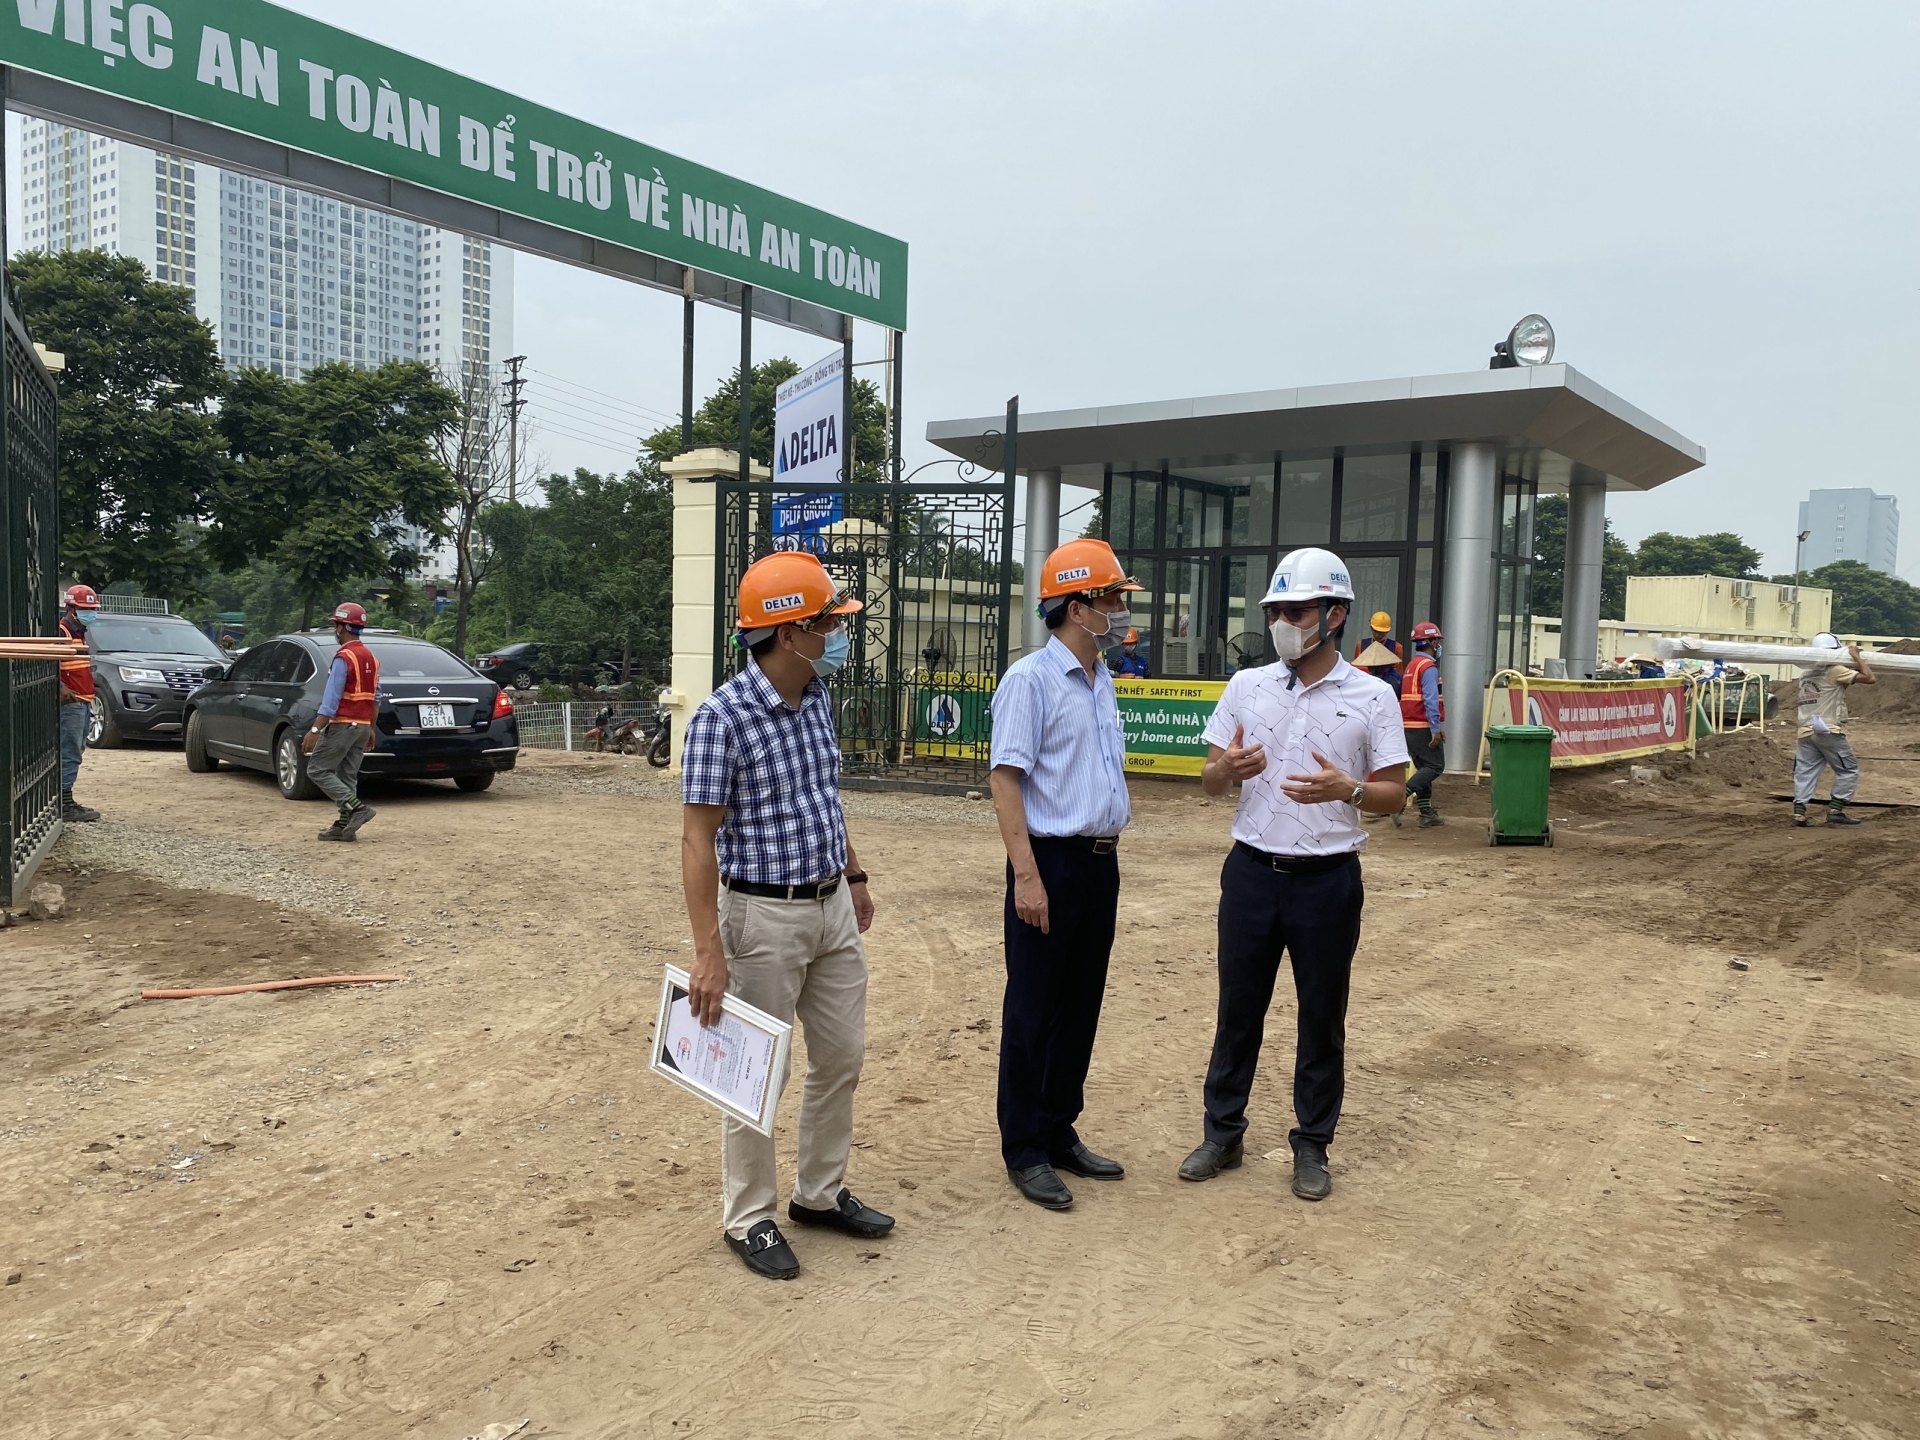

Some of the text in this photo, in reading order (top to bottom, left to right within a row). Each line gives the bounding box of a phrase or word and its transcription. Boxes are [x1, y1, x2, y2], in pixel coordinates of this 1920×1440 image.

[196, 25, 280, 106] AN
[299, 59, 440, 158] TOÀN
[458, 114, 516, 182] ĐỂ
[530, 151, 612, 210] TRỞ
[624, 167, 670, 231] VỀ
[682, 193, 751, 257] NHÀ
[760, 222, 800, 273] AN
[810, 245, 881, 299] TOÀN
[790, 414, 837, 470] DELTA
[1058, 569, 1088, 581] DELTA
[765, 596, 801, 610] DELTA
[1130, 683, 1144, 696] HẾT
[1150, 688, 1179, 697] SAFETY
[1180, 689, 1202, 698] FIRST
[427, 706, 446, 716] 29A
[1145, 708, 1170, 725] MỖI
[1172, 712, 1200, 727] NHÀ
[422, 716, 453, 727] 081.14
[1141, 731, 1173, 744] home
[1176, 733, 1201, 745] and
[1129, 757, 1155, 767] GROUP
